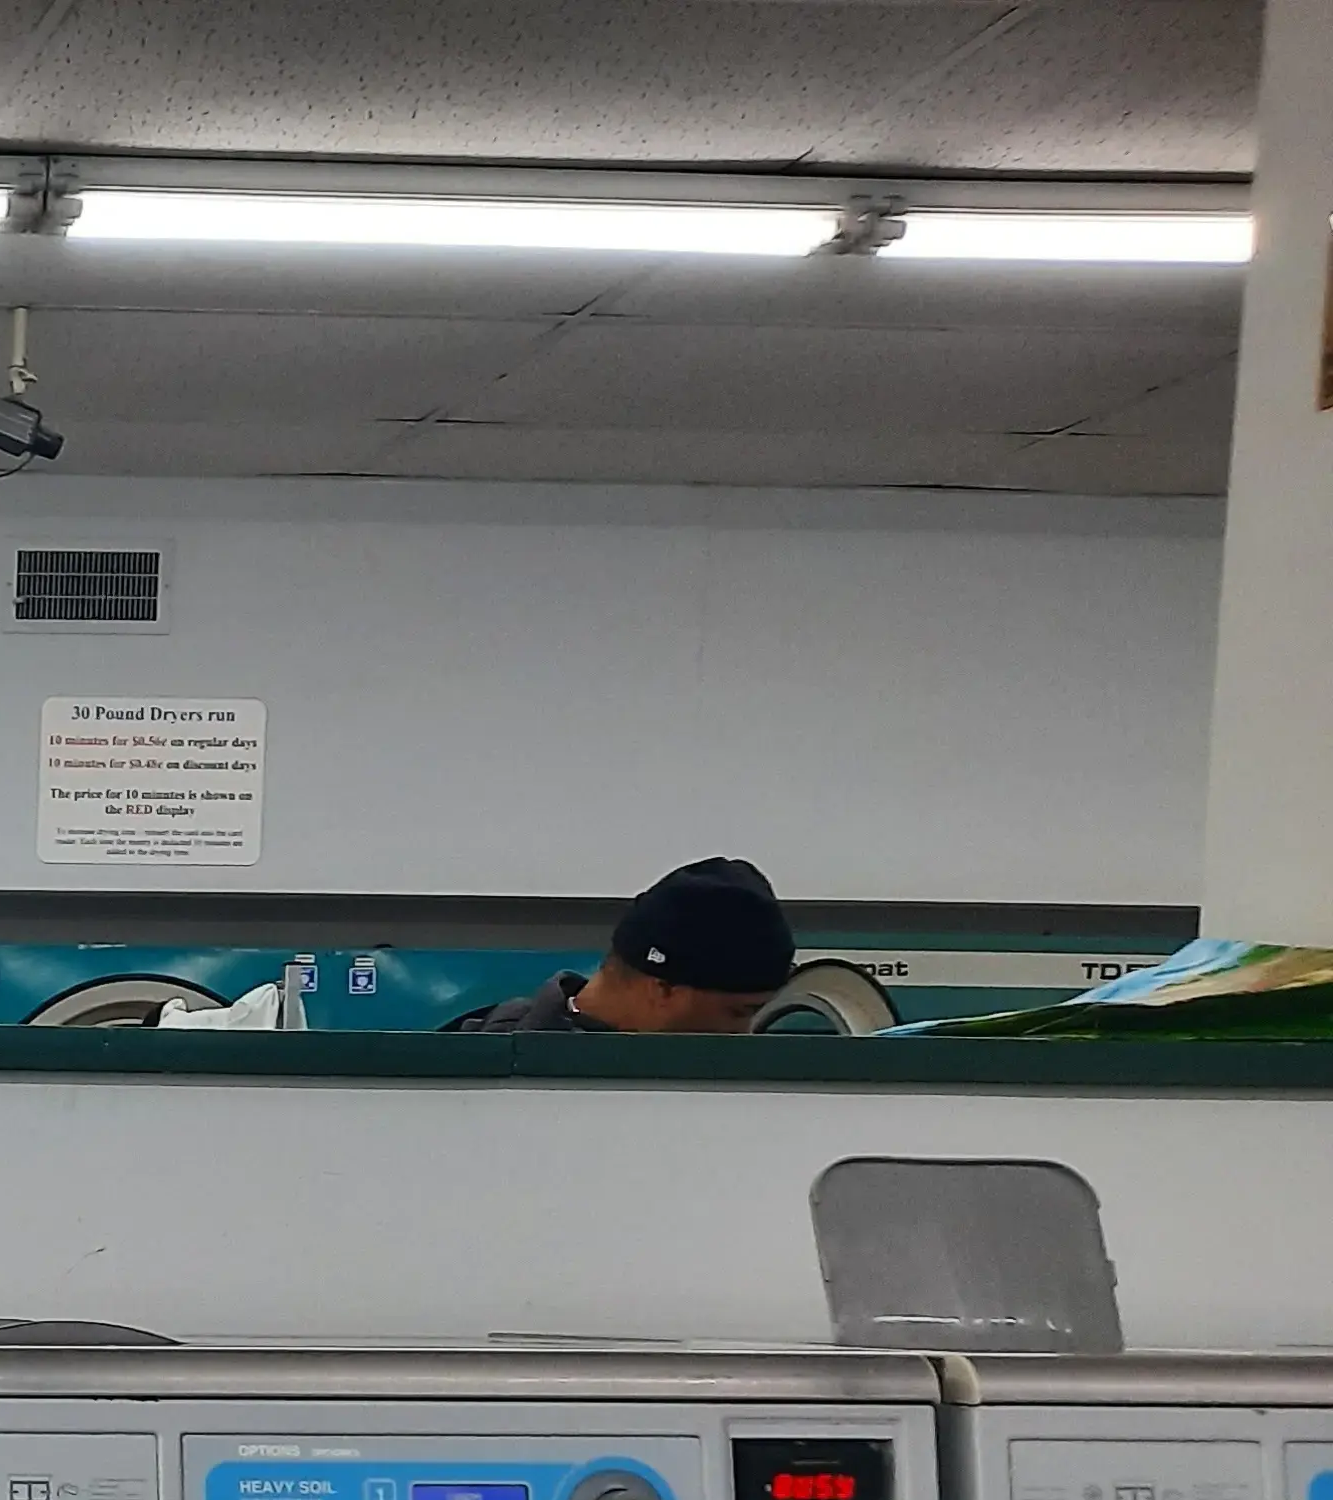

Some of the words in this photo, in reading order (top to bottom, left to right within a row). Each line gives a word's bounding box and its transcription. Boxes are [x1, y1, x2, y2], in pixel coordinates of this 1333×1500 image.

[71, 705, 90, 721] 30
[95, 706, 145, 721] Pound
[150, 707, 203, 724] Dryers
[208, 709, 236, 722] run
[49, 735, 62, 746] 10
[112, 736, 128, 747] for
[188, 737, 229, 750] regular
[232, 737, 258, 750] days
[48, 758, 61, 768] 10
[232, 760, 257, 773] days
[50, 788, 71, 800] The
[74, 788, 103, 801] price
[106, 788, 123, 800] for
[126, 789, 139, 800] 10
[105, 804, 123, 815] the
[126, 804, 153, 815] RED
[156, 805, 196, 818] display
[238, 1444, 301, 1457] OPTIONS
[239, 1480, 295, 1494] HEAVY
[299, 1480, 339, 1495] SOIL
